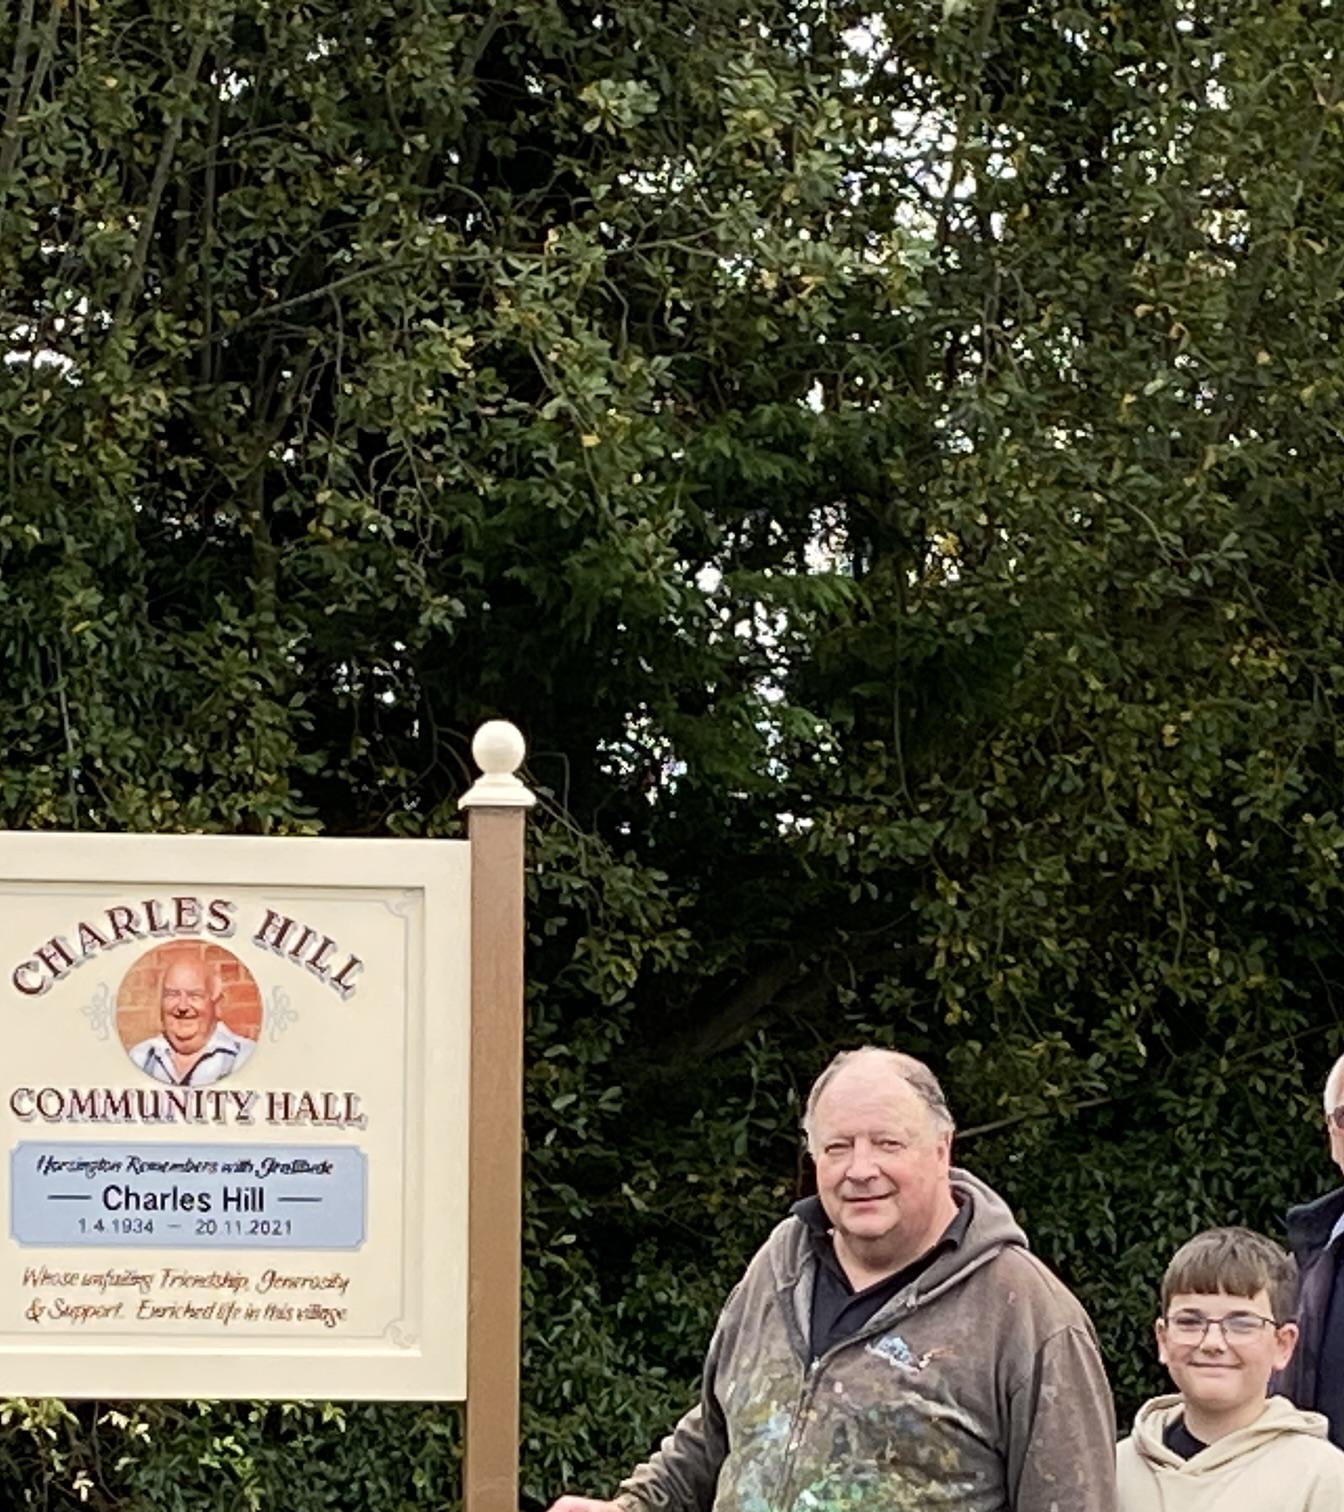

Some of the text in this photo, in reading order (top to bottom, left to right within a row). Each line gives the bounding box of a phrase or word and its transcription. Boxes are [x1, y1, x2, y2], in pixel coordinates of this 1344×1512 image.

[12, 897, 363, 998] CHARLES HILL
[10, 1087, 367, 1129] COMMUNITY HALL
[102, 1185, 265, 1212] Charles Hill
